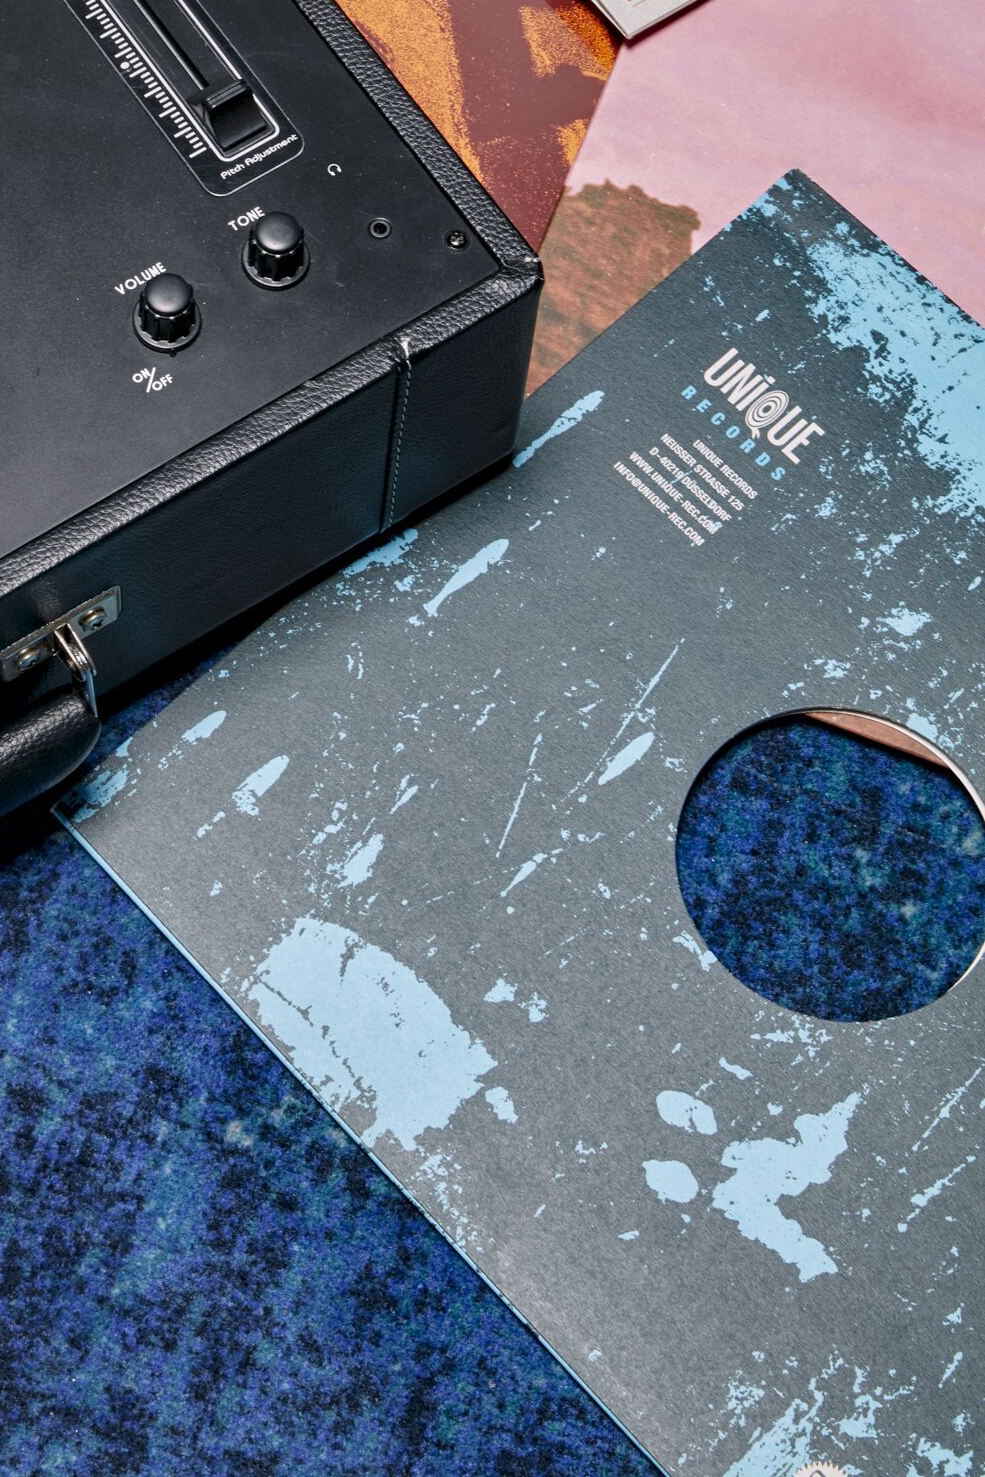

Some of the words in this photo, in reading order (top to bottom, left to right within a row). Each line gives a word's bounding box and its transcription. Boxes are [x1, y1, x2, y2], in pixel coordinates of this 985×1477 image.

[219, 163, 245, 179] Pitch
[244, 133, 297, 166] Adjustment
[227, 206, 265, 230] TONE
[114, 261, 166, 294] VOLUME
[131, 366, 174, 394] ON/OFF
[680, 385, 786, 483] RECORDS
[629, 451, 720, 534] WWW.UNIQUE-REC.COM
[660, 433, 696, 467] NEUSSER
[693, 464, 730, 497] STRASSE
[727, 494, 744, 511] 125
[692, 439, 723, 467] UNIQUE
[719, 464, 757, 499] RECORDS
[613, 461, 704, 545] INFO@UNIQUE-REC.COM
[680, 474, 731, 521] DÜSSELDORF
